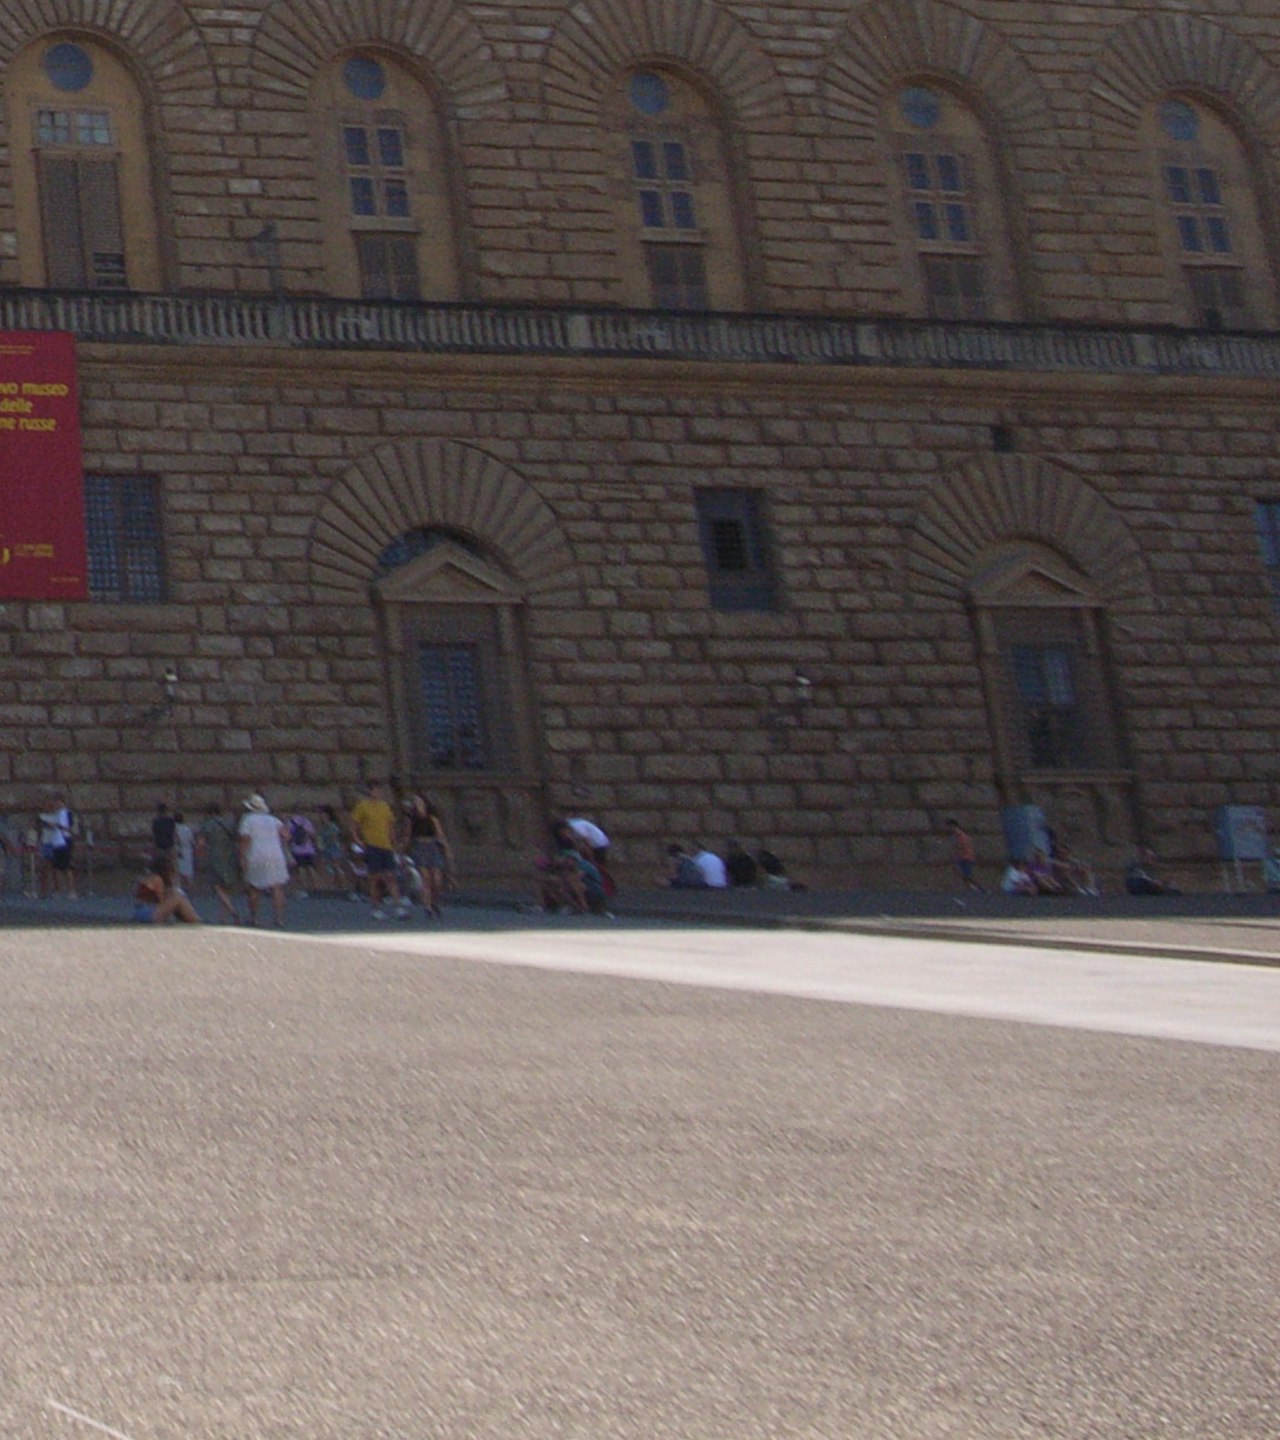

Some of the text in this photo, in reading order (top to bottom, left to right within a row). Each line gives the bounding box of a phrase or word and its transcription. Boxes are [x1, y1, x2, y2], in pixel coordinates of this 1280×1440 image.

[22, 383, 69, 397] museo
[0, 397, 33, 413] delle
[19, 418, 57, 432] russe
